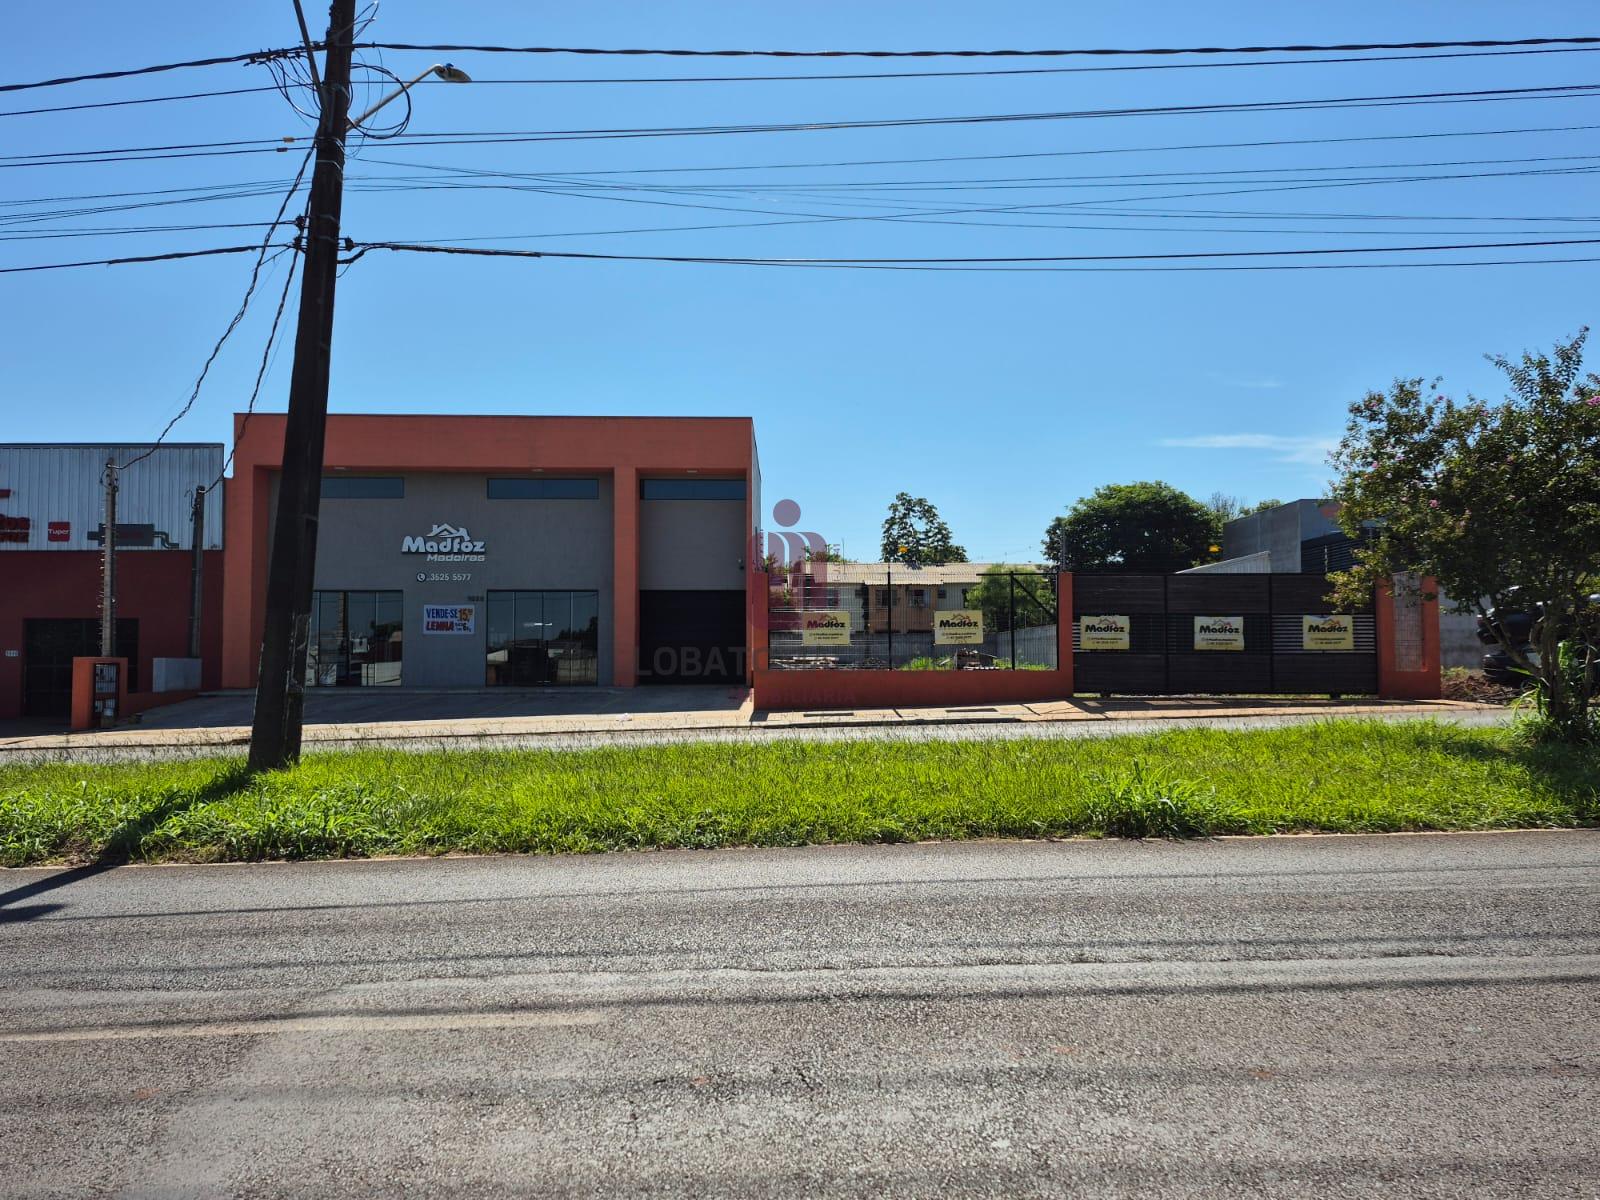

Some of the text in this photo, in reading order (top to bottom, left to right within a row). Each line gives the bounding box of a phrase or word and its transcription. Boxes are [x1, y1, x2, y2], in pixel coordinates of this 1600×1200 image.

[401, 536, 485, 552] Madfoz
[426, 554, 485, 562] Madeiras
[430, 573, 450, 581] 3525
[426, 608, 458, 619] VENDE-SE
[806, 620, 846, 628] Madfoz
[939, 619, 979, 628] Madfoz
[1084, 624, 1126, 633] Madfoz
[1199, 624, 1240, 634] Madfoz
[1307, 624, 1348, 633] Madfoz
